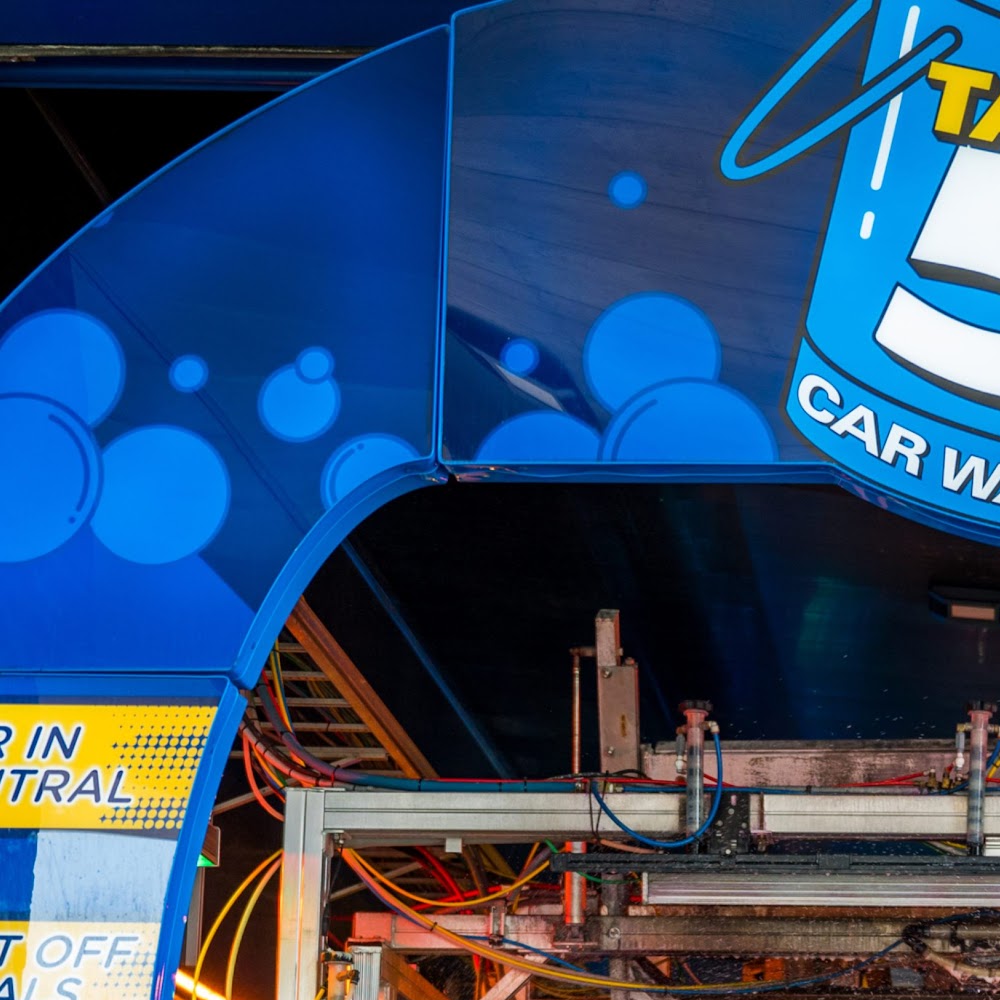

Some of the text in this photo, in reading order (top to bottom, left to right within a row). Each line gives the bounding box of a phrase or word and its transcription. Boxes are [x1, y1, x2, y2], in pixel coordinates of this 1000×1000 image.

[797, 374, 930, 478] CAR
[26, 726, 82, 759] IN
[0, 769, 131, 803] TRAL
[35, 935, 139, 968] OFF
